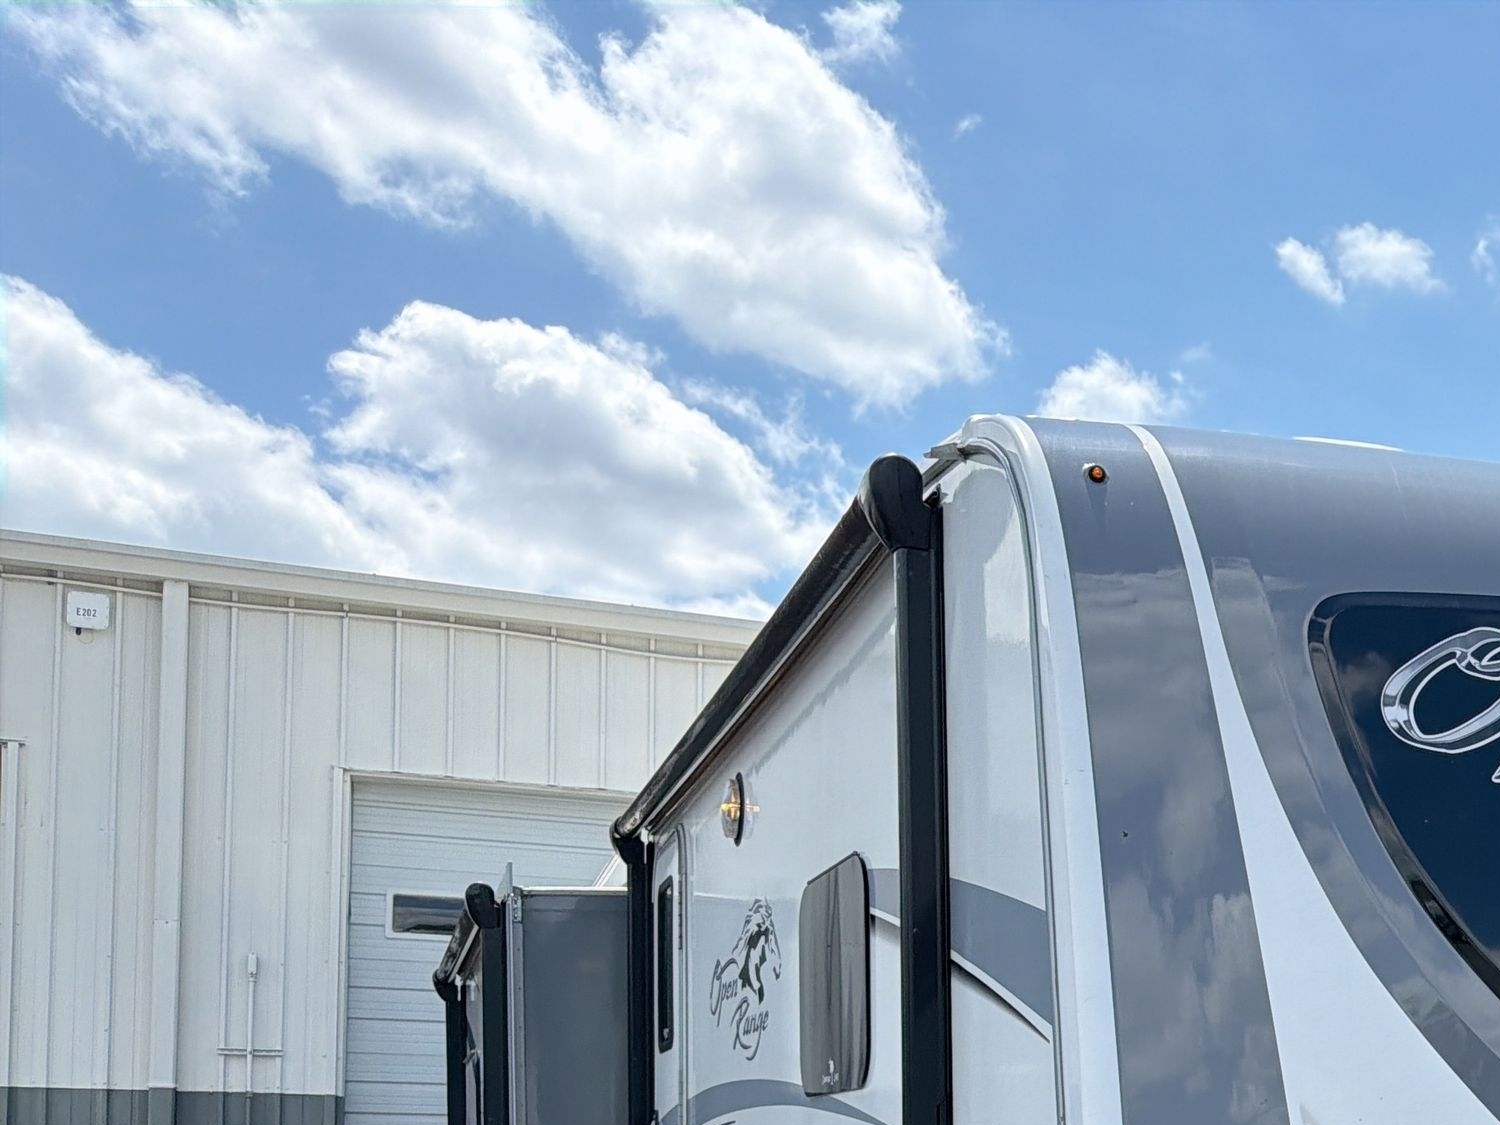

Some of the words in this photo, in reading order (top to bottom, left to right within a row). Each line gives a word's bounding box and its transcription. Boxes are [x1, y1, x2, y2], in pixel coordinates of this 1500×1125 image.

[76, 608, 97, 617] E202
[710, 957, 740, 1027] Open
[730, 996, 769, 1061] Range
